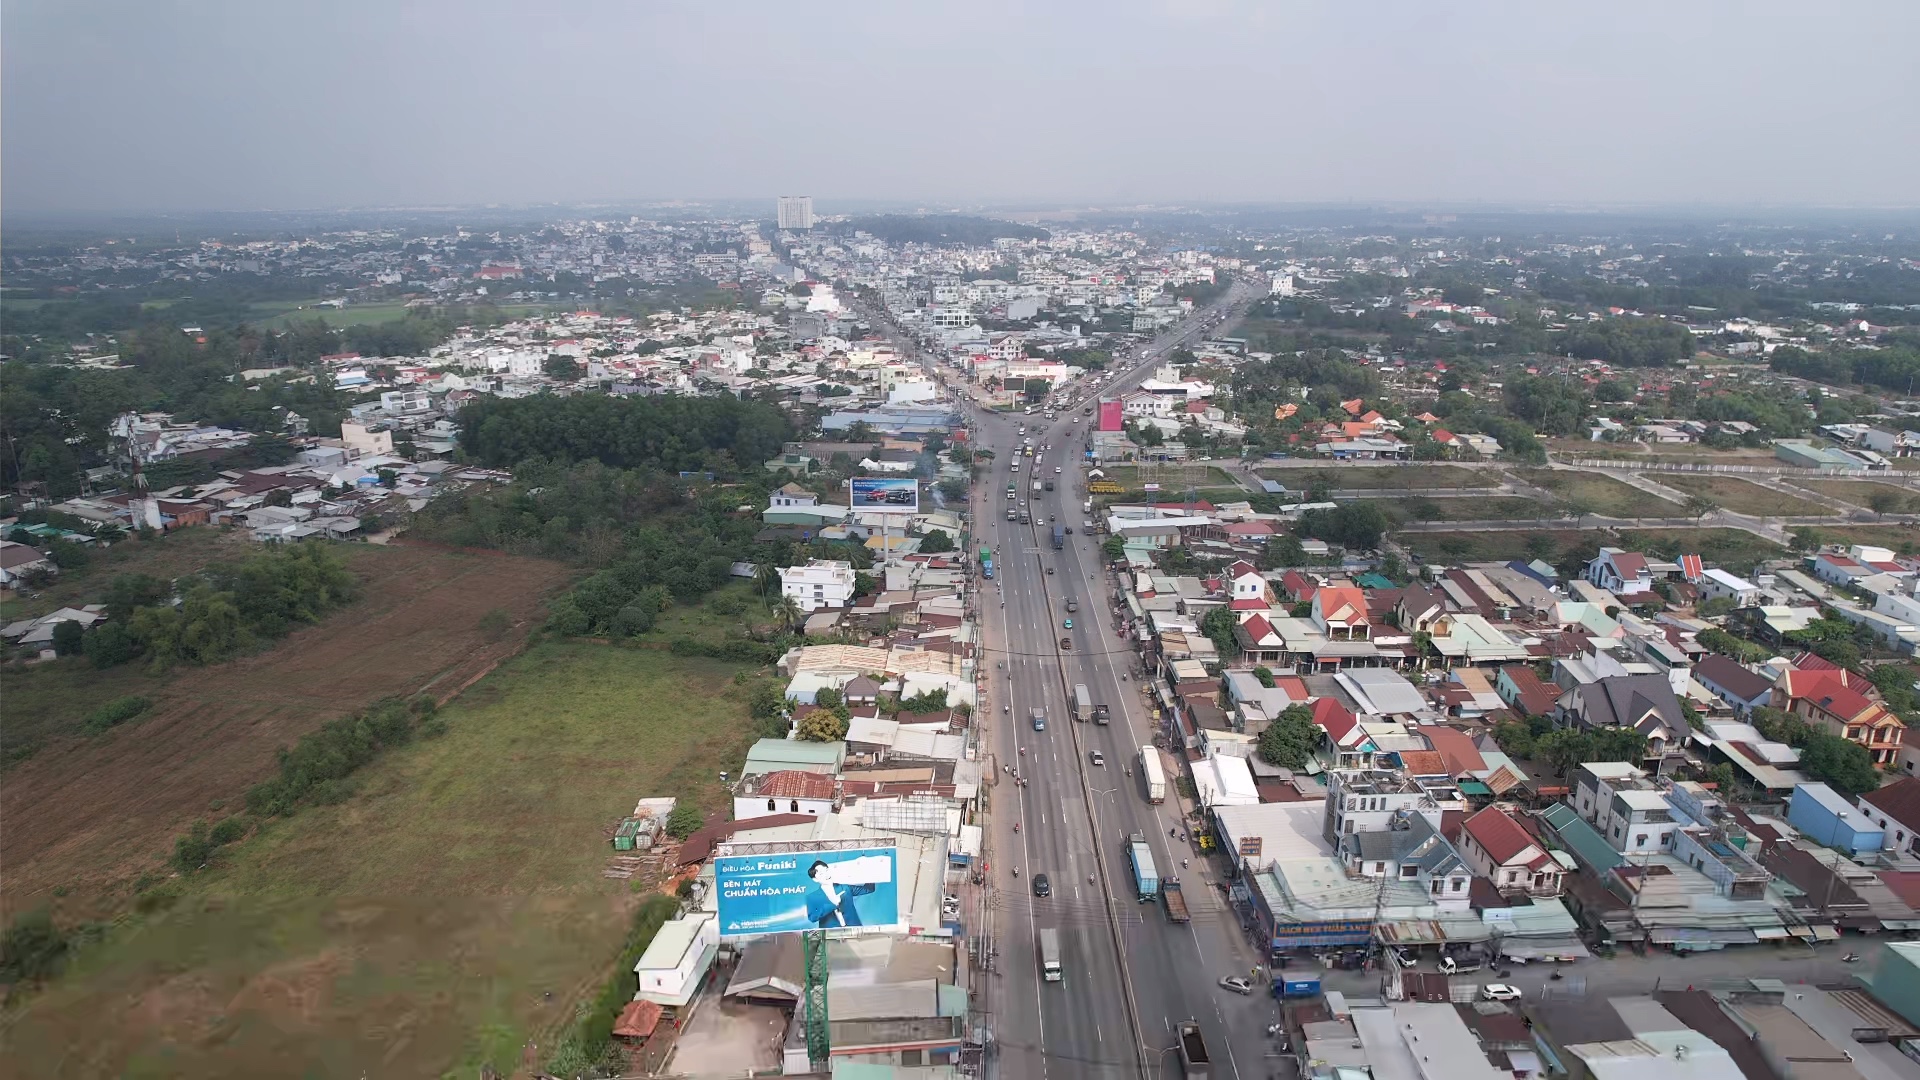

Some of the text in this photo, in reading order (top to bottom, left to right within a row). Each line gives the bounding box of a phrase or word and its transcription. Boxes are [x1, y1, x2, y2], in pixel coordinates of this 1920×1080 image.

[757, 860, 796, 870] Funiki
[743, 879, 762, 887] MÁT
[760, 887, 781, 895] HÒA
[783, 885, 807, 894] PHÁT
